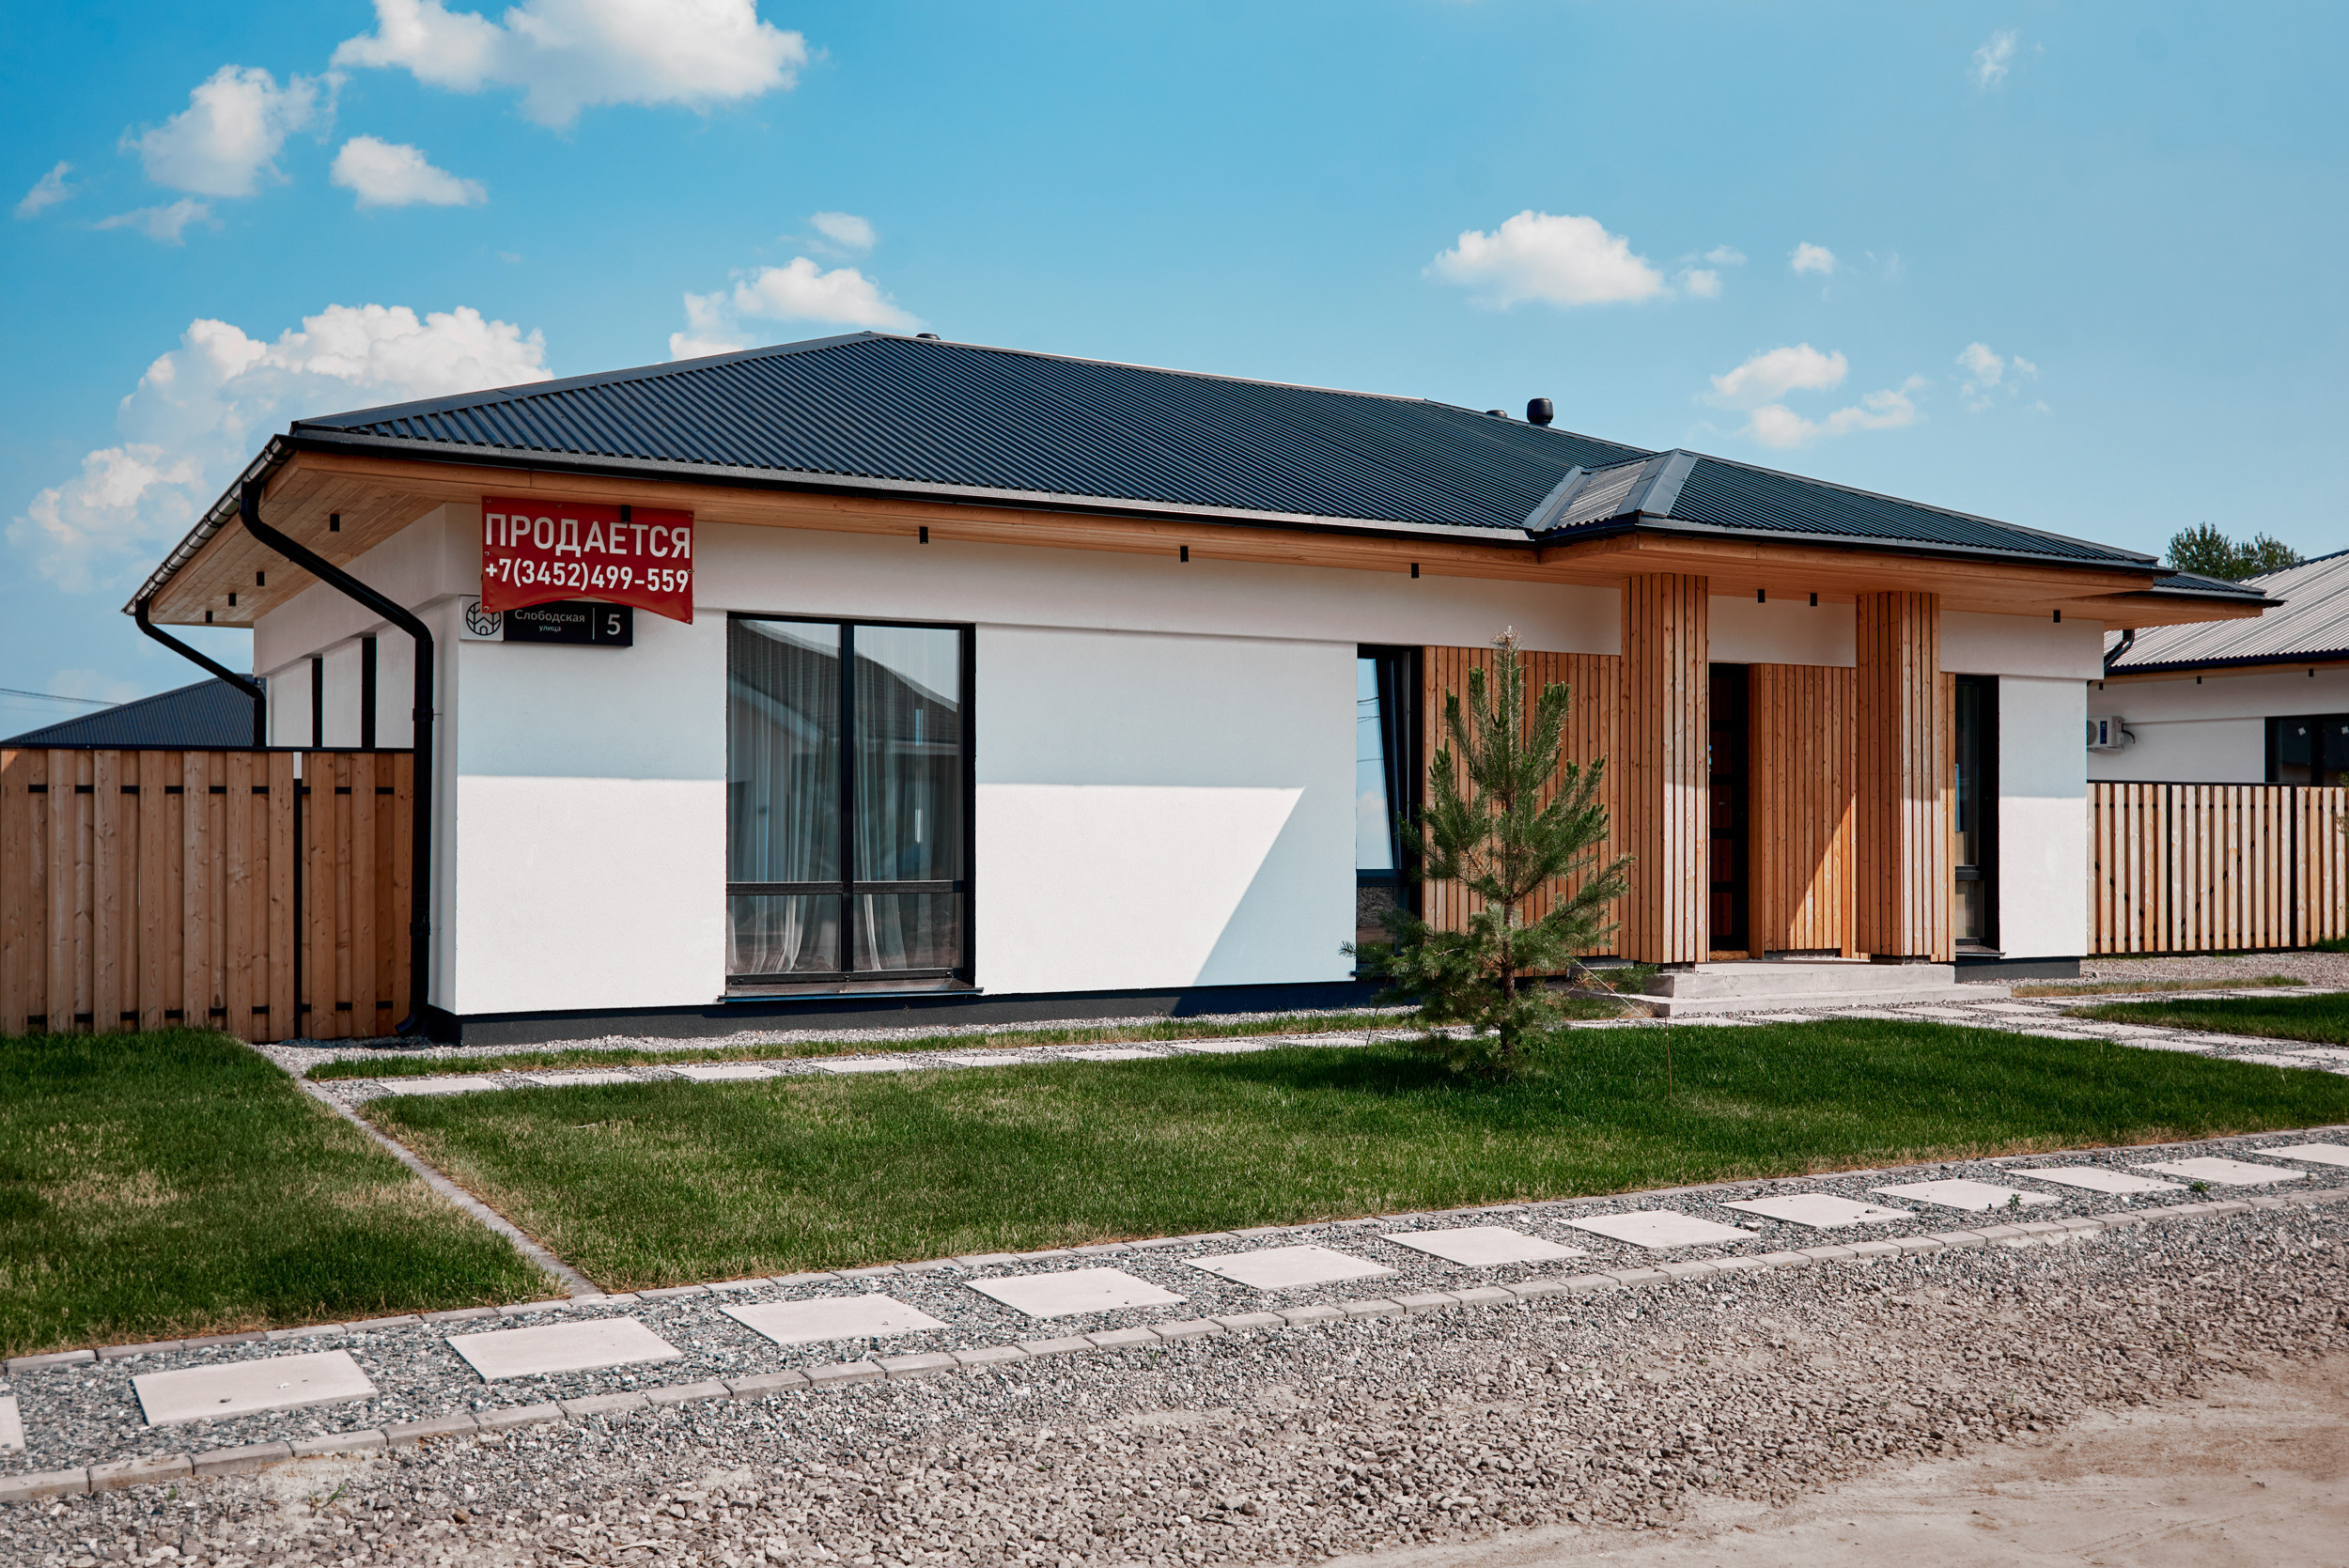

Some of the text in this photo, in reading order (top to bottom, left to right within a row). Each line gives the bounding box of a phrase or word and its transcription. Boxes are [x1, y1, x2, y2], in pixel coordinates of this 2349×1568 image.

[486, 513, 691, 558] ПРОДАЕТСЯ
[485, 558, 689, 593] +7(3452)499-559
[514, 610, 585, 623] Слободская
[538, 624, 562, 632] улица
[606, 613, 621, 636] 5
